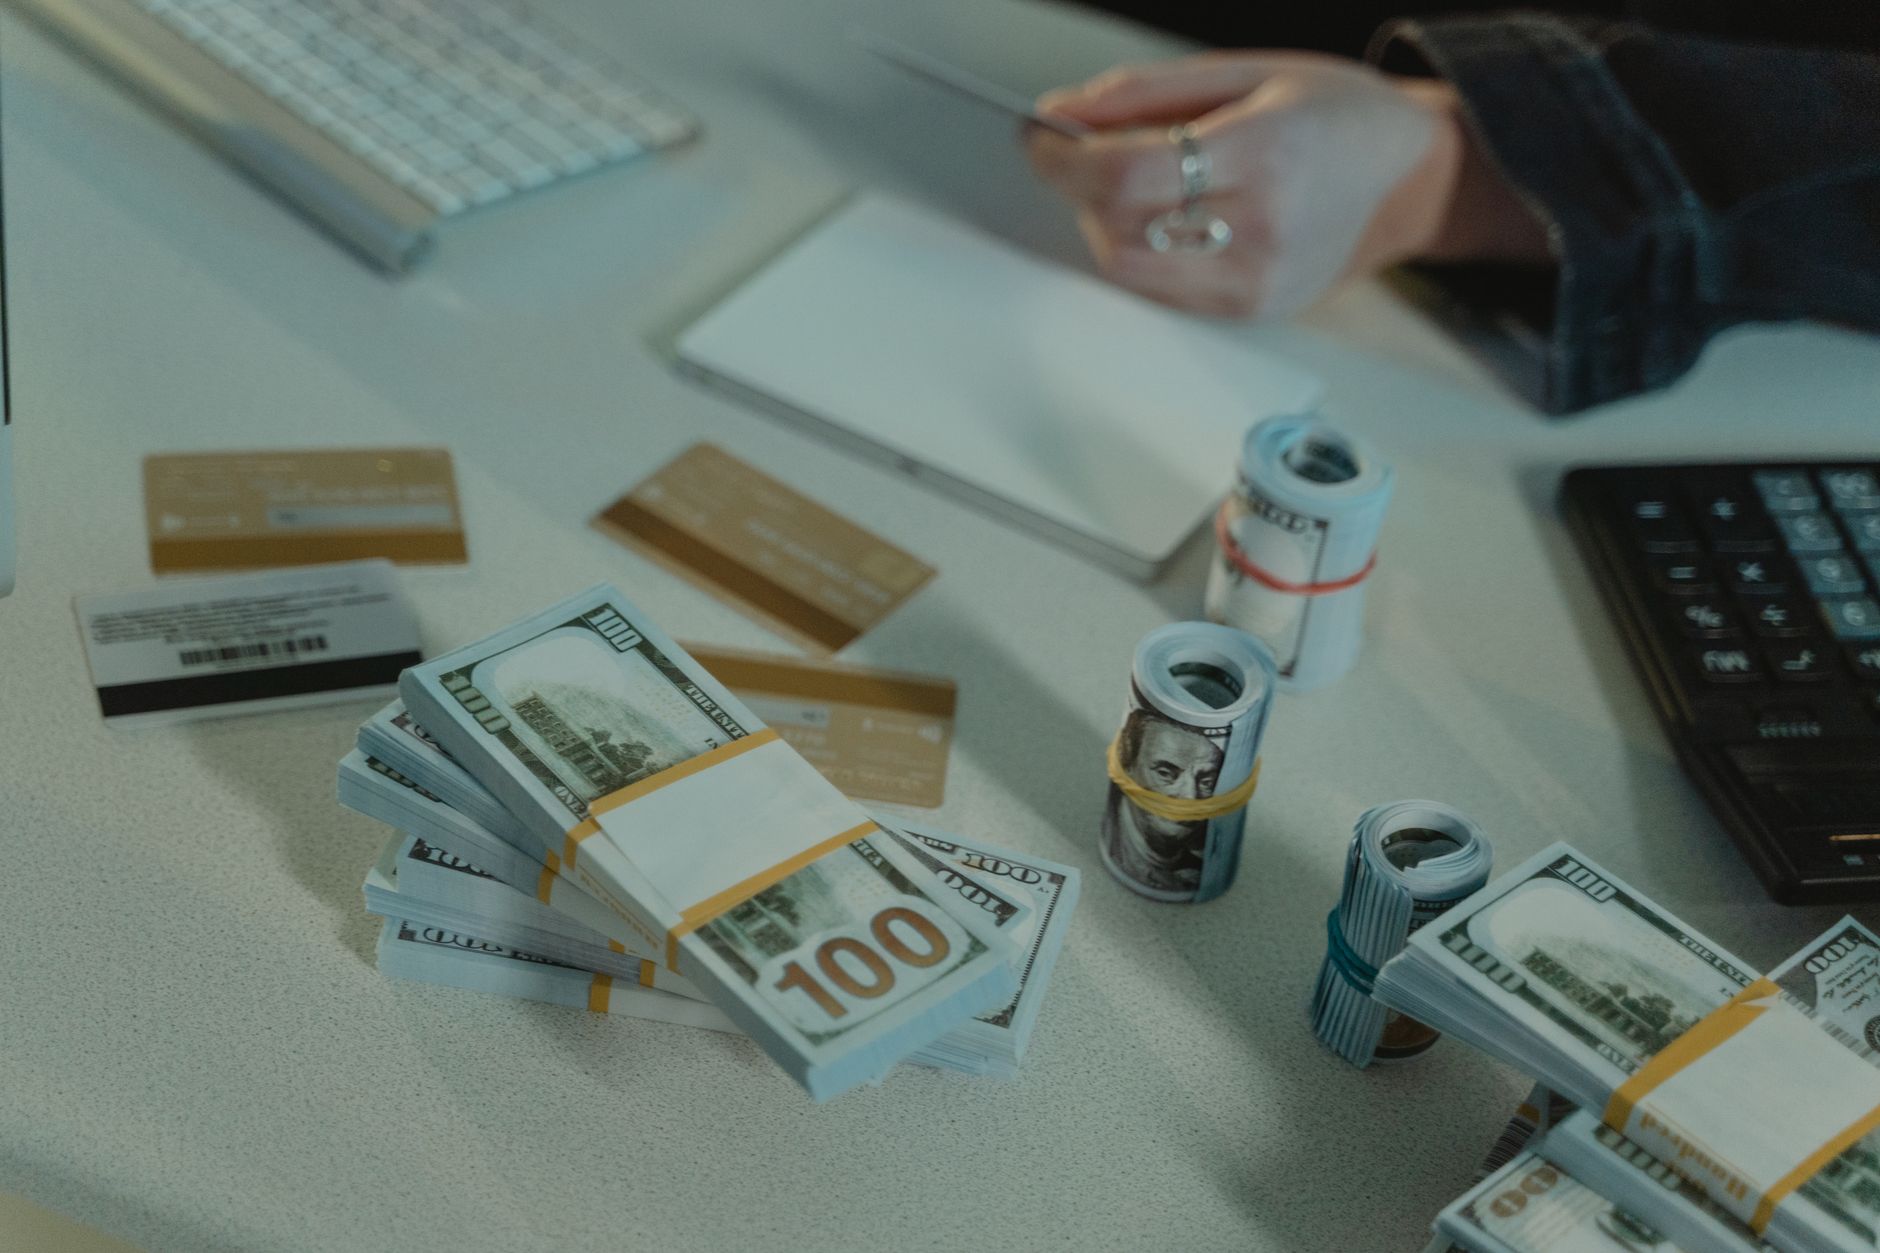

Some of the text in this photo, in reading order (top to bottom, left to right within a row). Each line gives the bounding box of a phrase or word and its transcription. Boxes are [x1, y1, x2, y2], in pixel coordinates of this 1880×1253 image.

[588, 607, 642, 652] 100
[440, 674, 511, 735] 100
[686, 684, 717, 712] THE
[555, 785, 583, 813] ONE
[962, 852, 1041, 884] 100
[1552, 860, 1617, 903] 100
[774, 907, 950, 1019] 100
[1443, 935, 1527, 993] 100
[1803, 936, 1860, 975] 100
